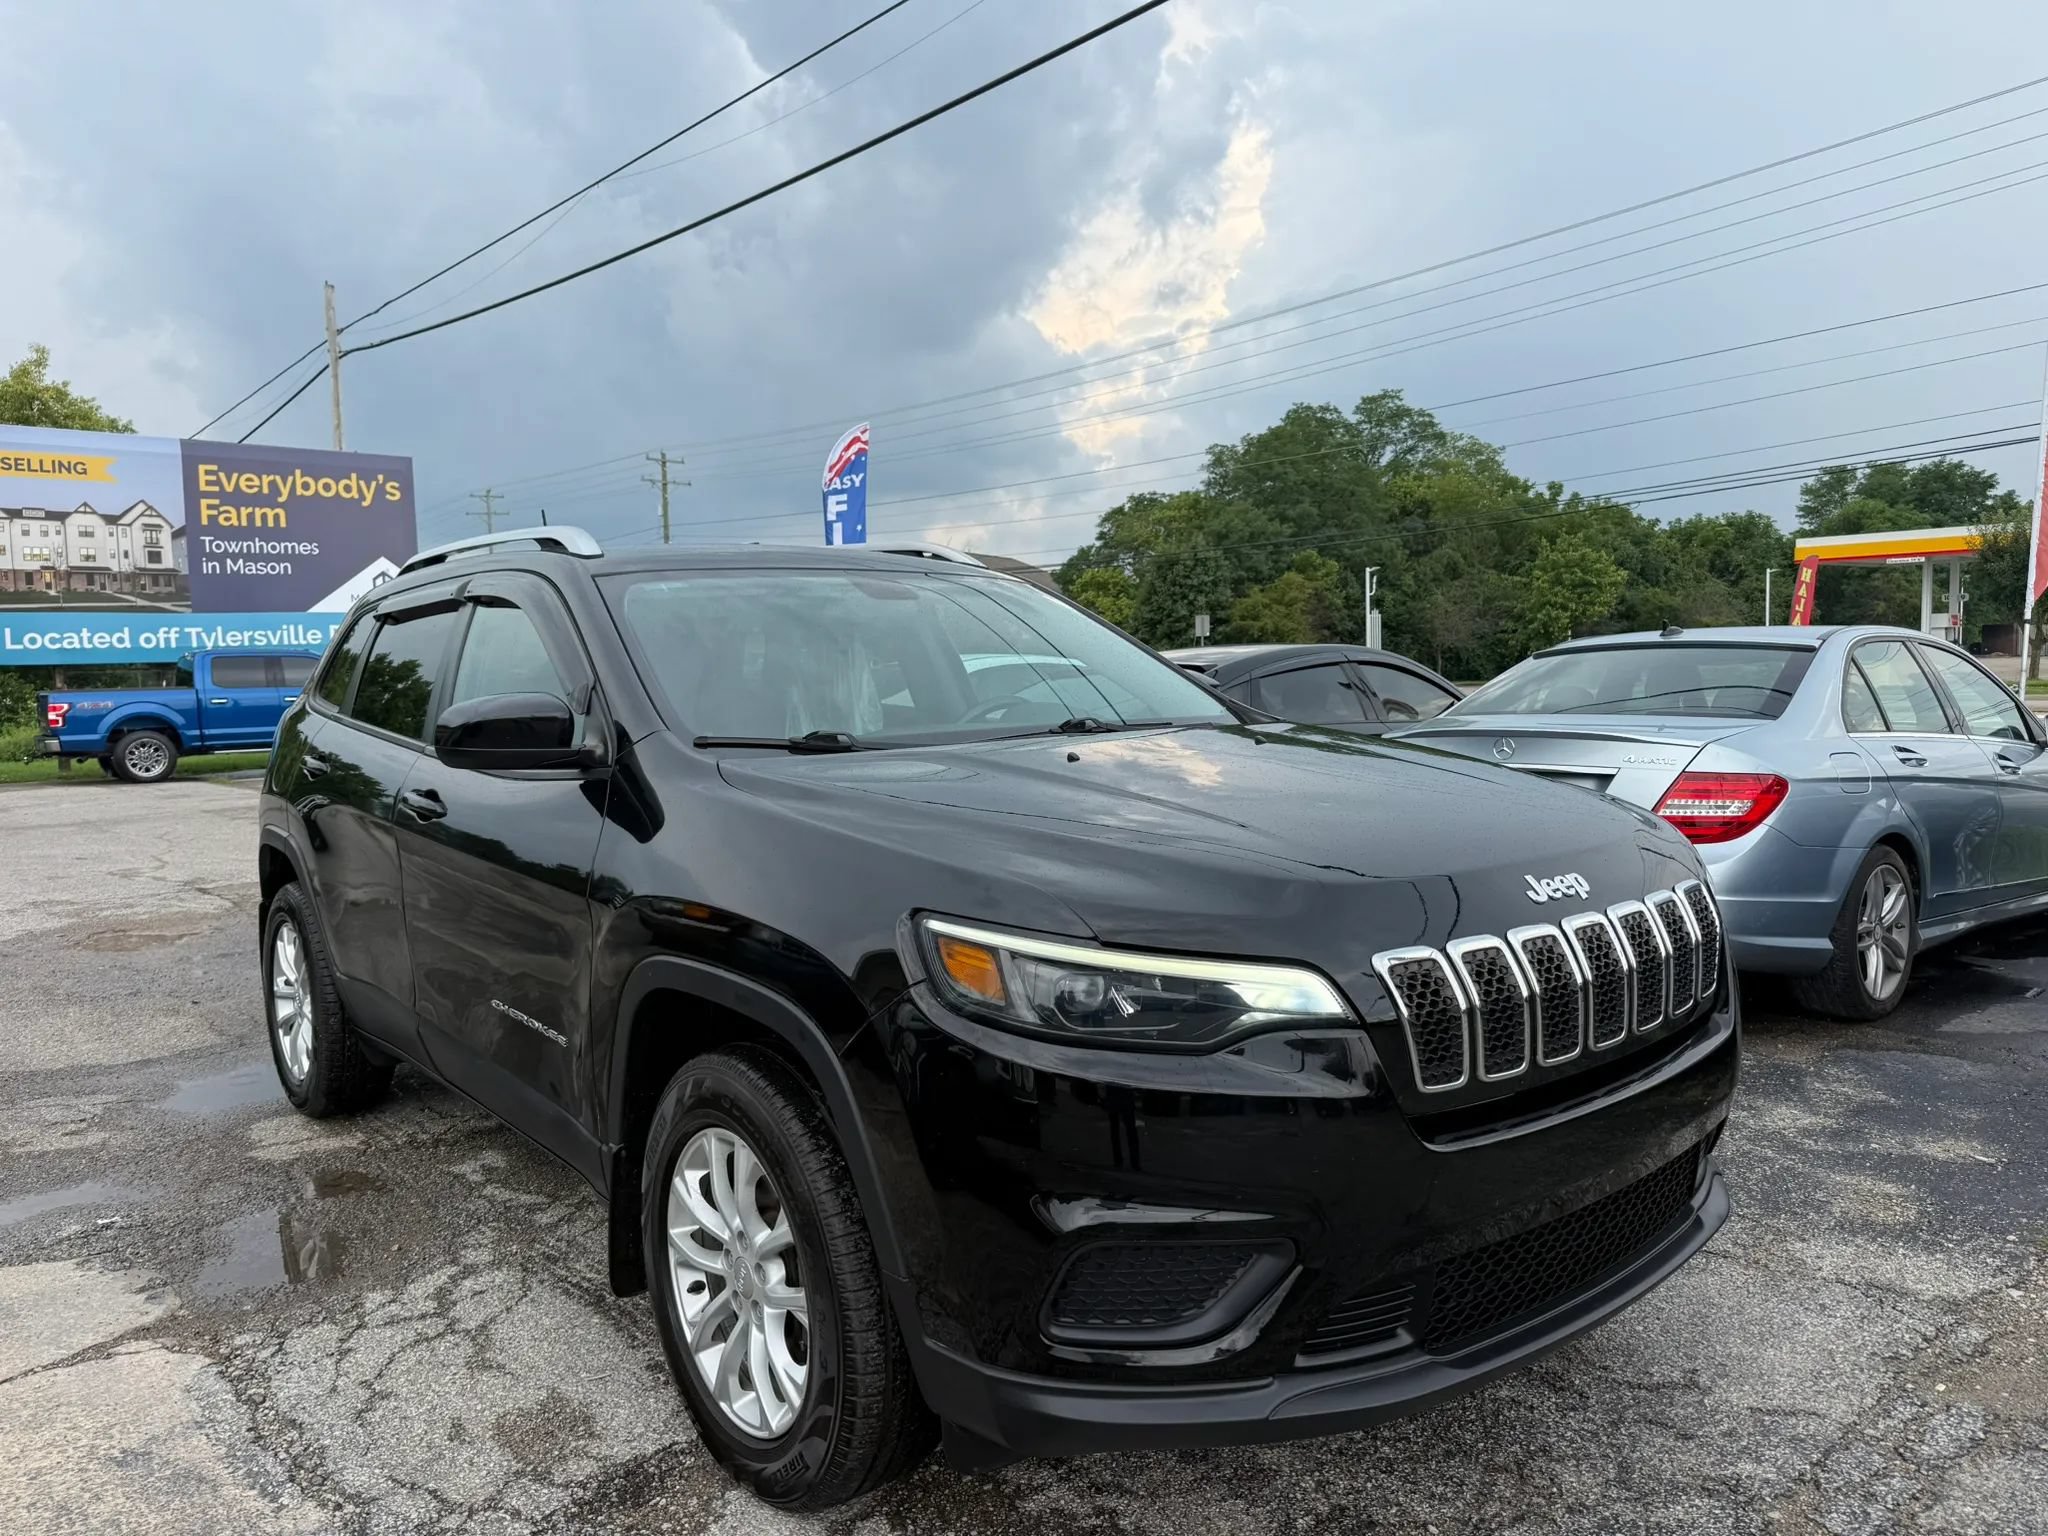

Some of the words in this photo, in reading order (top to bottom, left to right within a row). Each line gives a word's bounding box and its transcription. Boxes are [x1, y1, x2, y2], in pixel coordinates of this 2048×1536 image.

[0, 457, 88, 476] SELLING
[198, 464, 402, 507] Everybody's
[200, 499, 288, 528] Farm
[200, 536, 320, 555] Townhomes
[202, 557, 221, 575] in
[226, 558, 292, 575] Mason
[4, 627, 131, 650] Located
[139, 627, 180, 649] off
[184, 624, 323, 650] Tylersville
[1523, 872, 1591, 903] Jeep
[490, 999, 569, 1048] CHEROKEE
